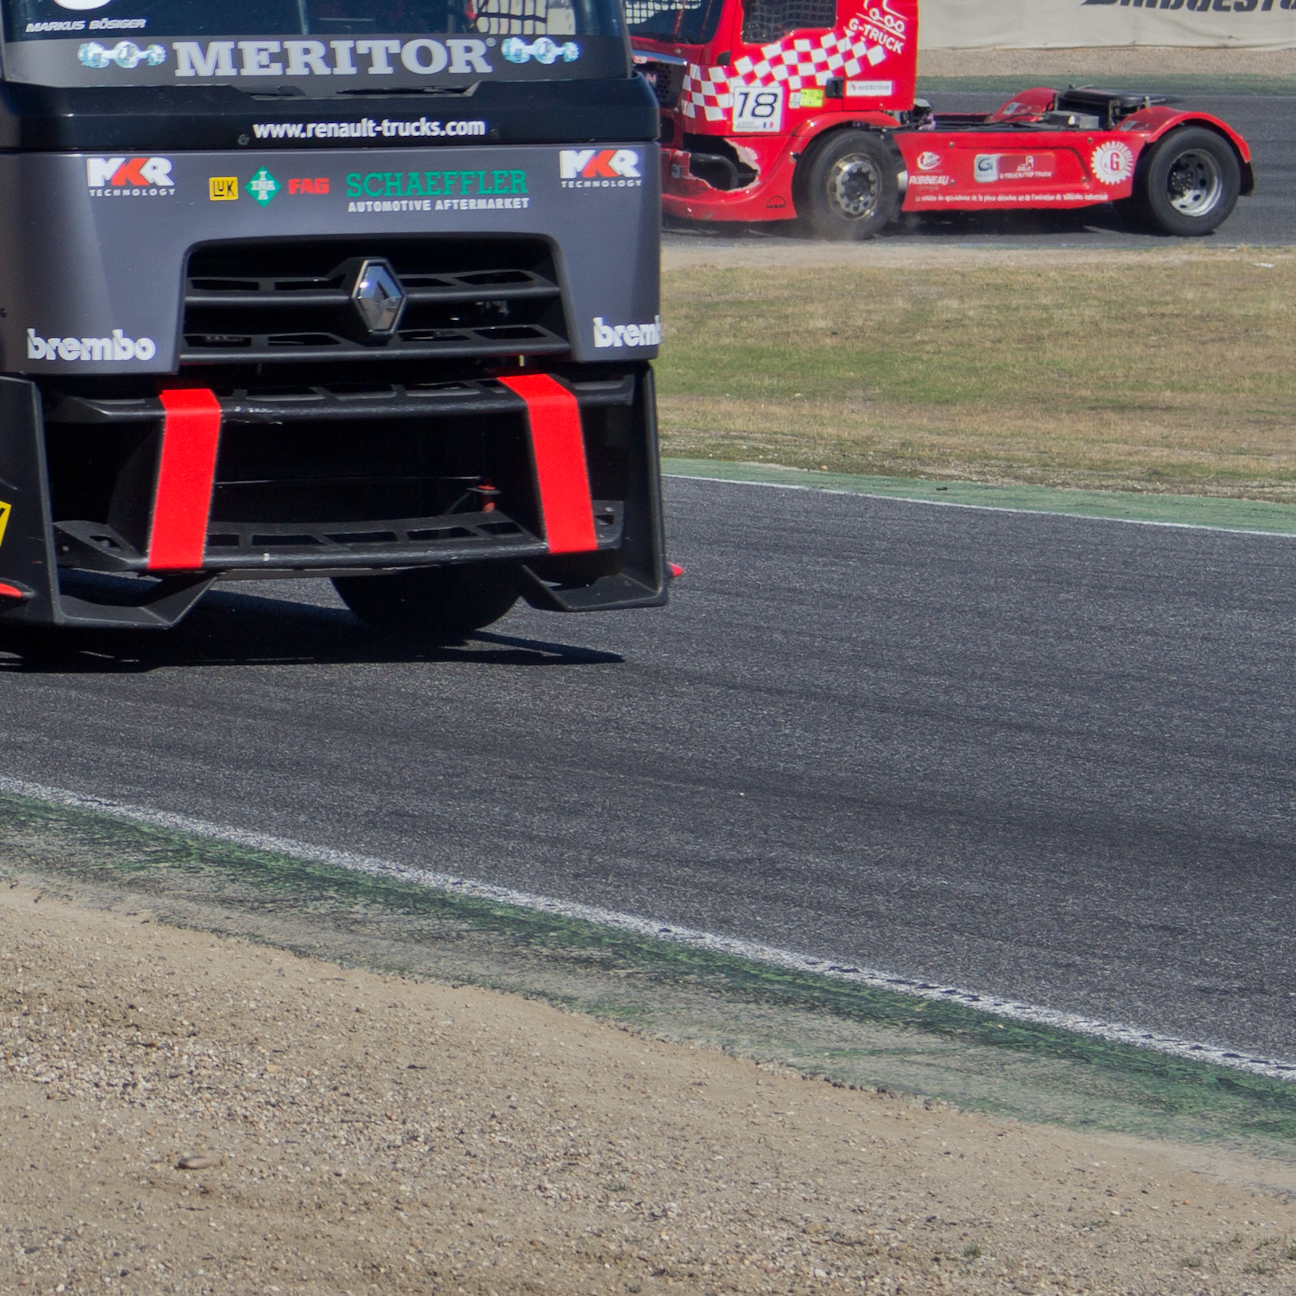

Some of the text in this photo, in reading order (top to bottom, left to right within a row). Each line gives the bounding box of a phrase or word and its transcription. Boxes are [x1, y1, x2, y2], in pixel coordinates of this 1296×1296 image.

[25, 17, 148, 33] MARKUS BÖSIGER
[848, 17, 904, 55] G-TRUCK
[171, 37, 495, 78] MERITOR
[737, 91, 778, 119] 18
[253, 117, 486, 141] www.renault-trucks.com
[89, 188, 177, 199] TECHNOLOGY
[287, 177, 331, 195] FAG
[346, 169, 529, 199] SCHAEFFLER
[561, 179, 644, 189] TECHNOLOGY
[347, 196, 530, 213] AUTOMOTIVE AFTERMARKET
[27, 328, 157, 362] brembo
[593, 316, 662, 350] brem
